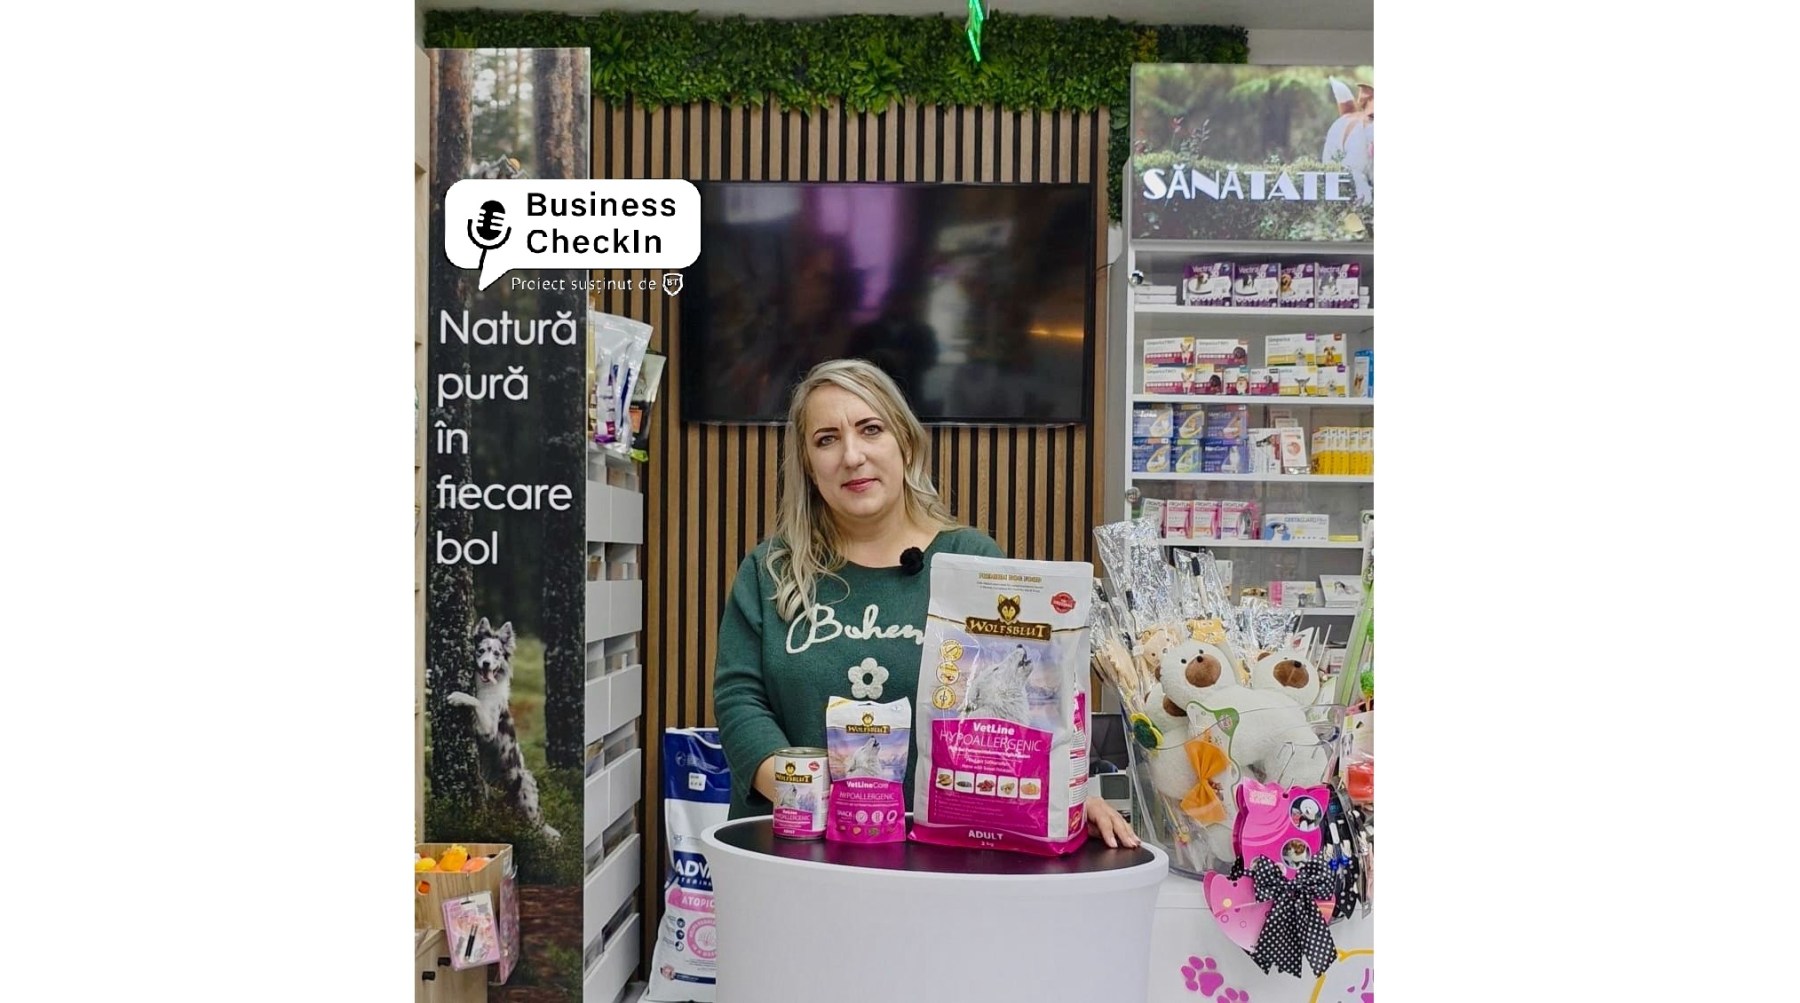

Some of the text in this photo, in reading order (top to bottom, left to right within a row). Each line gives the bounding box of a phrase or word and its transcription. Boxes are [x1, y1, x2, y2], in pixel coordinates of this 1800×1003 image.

[1143, 163, 1351, 200] SĂNĂTATE
[1281, 265, 1296, 274] ectra
[440, 310, 577, 345] Natură
[438, 365, 529, 407] pură
[434, 420, 468, 454] în
[436, 475, 573, 510] fiecare
[437, 531, 498, 564] bol
[970, 620, 1047, 637] WOLFSBLUT
[940, 730, 1042, 752] HYPOALLERGENIC
[973, 722, 1015, 735] VetLine
[968, 829, 1004, 840] ADULT
